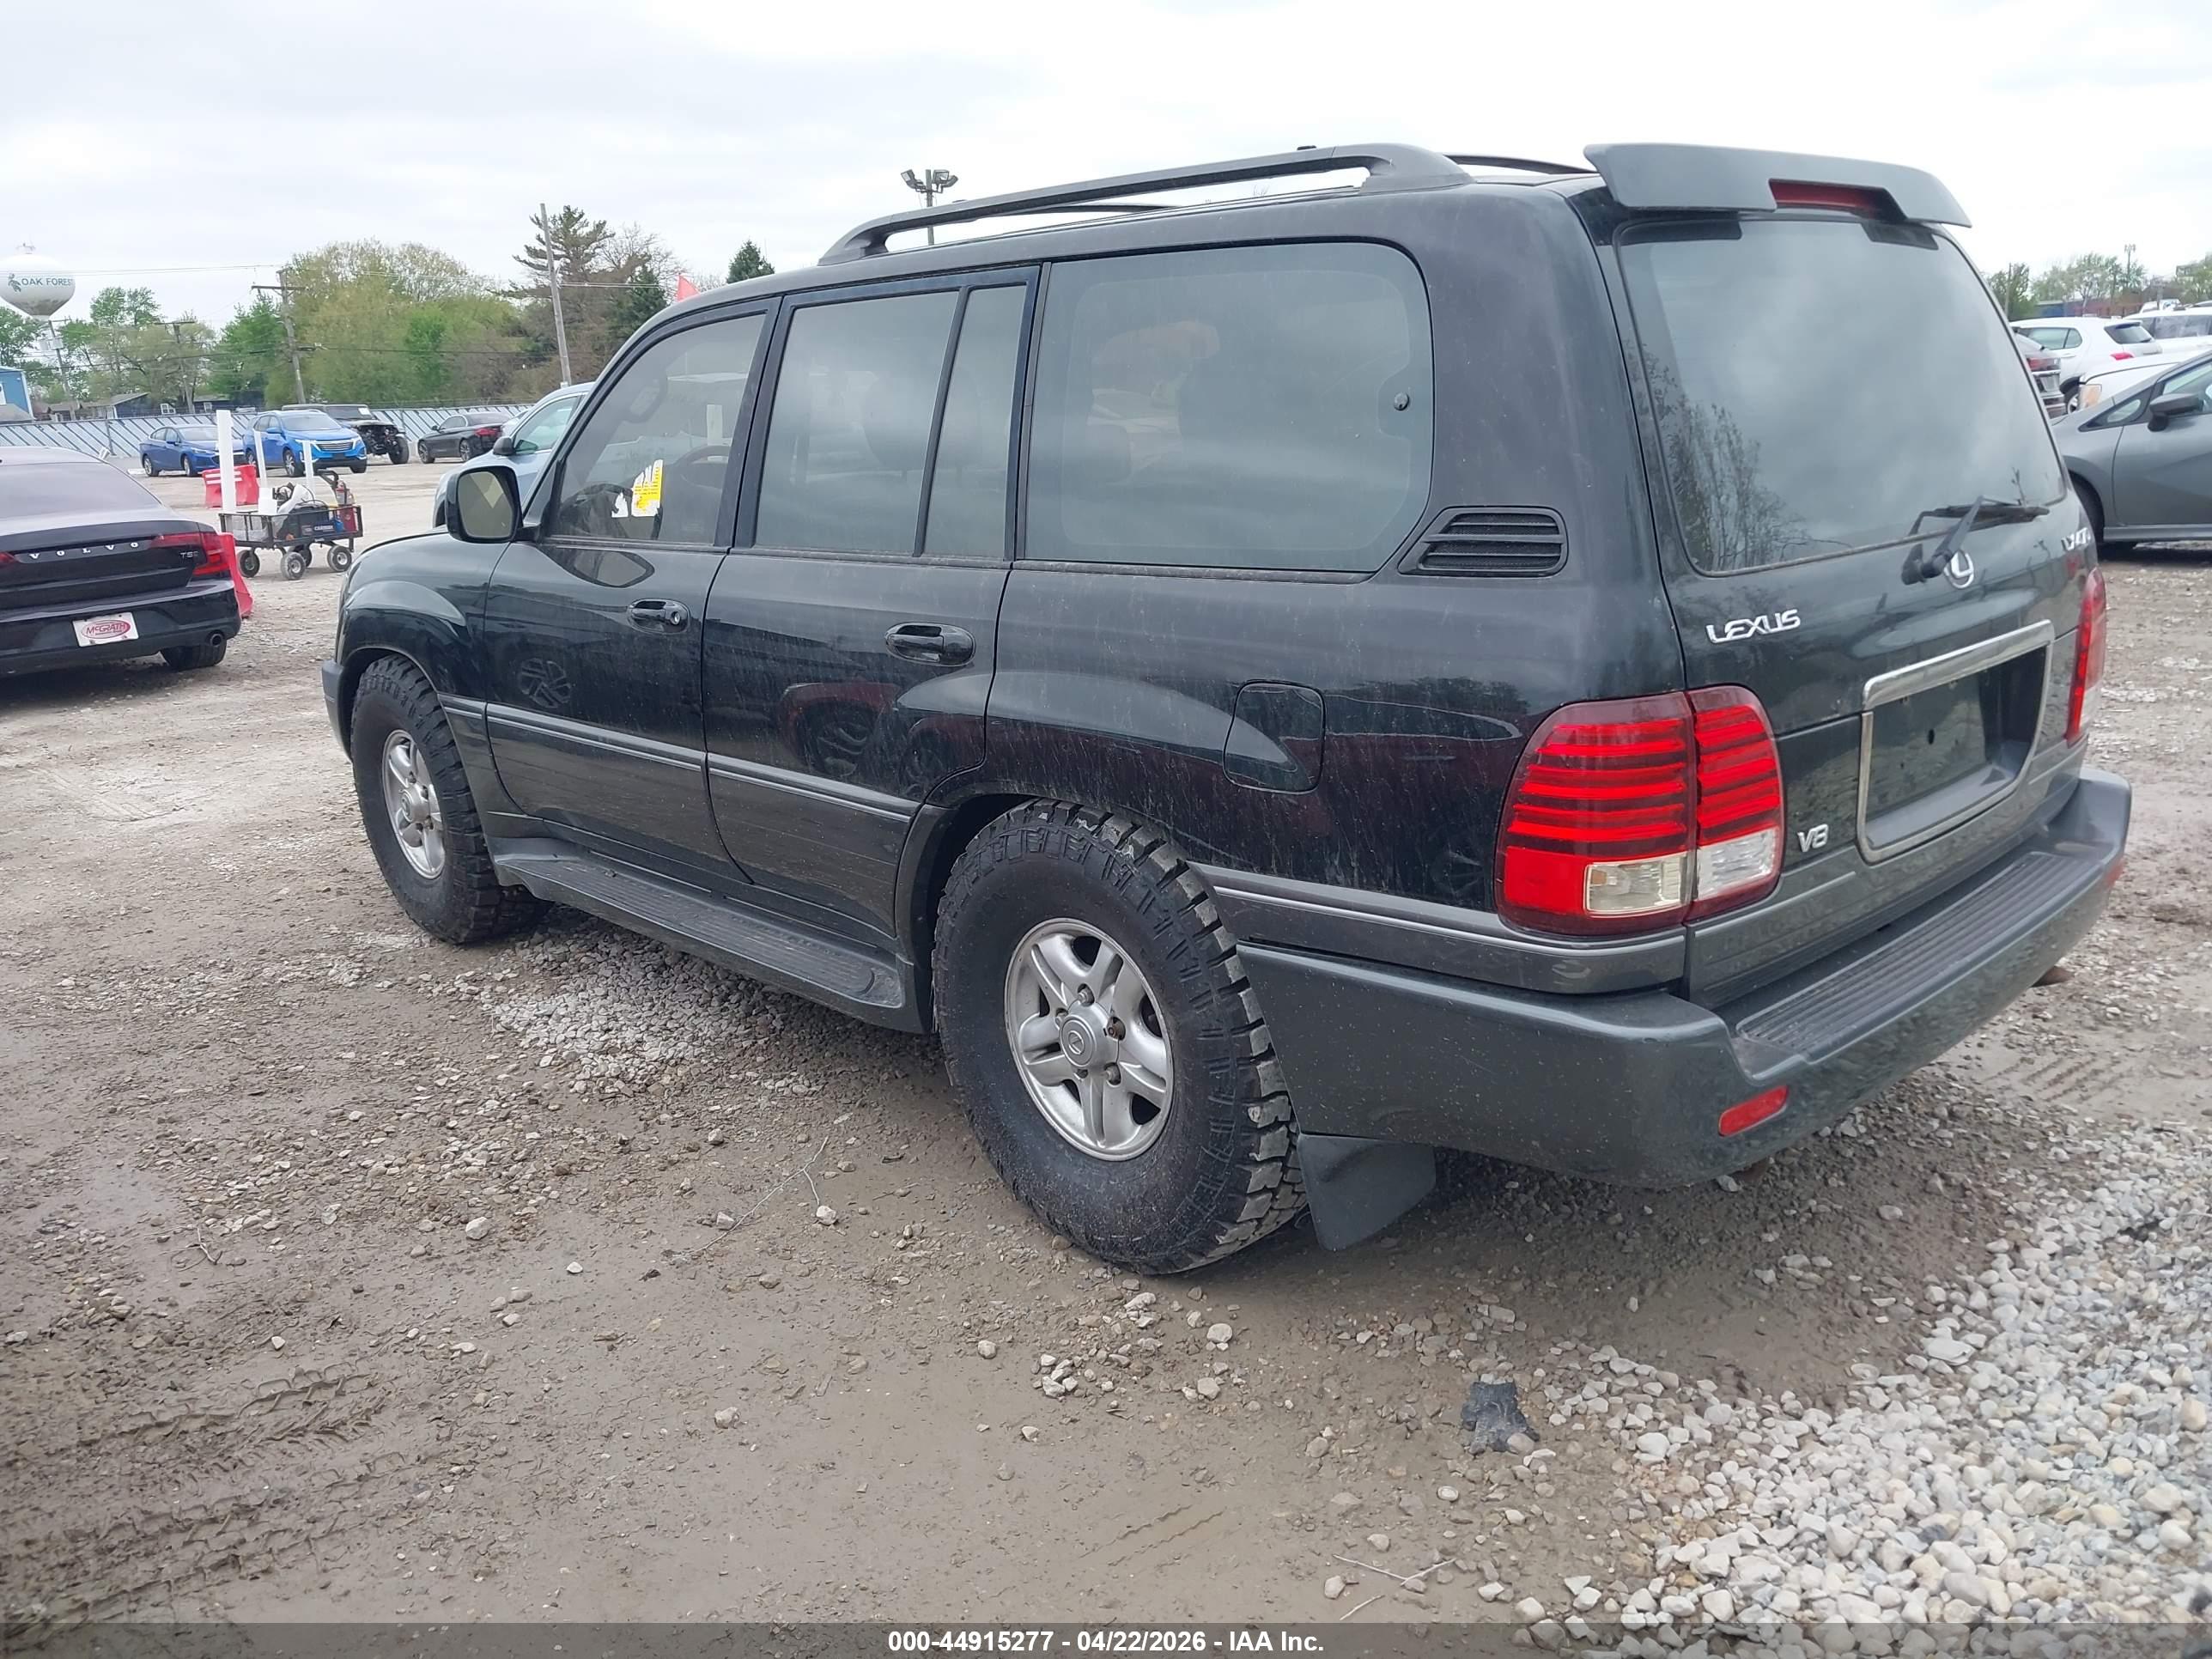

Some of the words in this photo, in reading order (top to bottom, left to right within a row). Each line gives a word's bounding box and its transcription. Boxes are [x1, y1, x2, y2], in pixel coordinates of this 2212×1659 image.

[21, 277, 43, 286] OAK
[29, 541, 139, 560] VOLVO
[1705, 609, 1801, 643] LEXUS
[1797, 823, 1828, 853] V8
